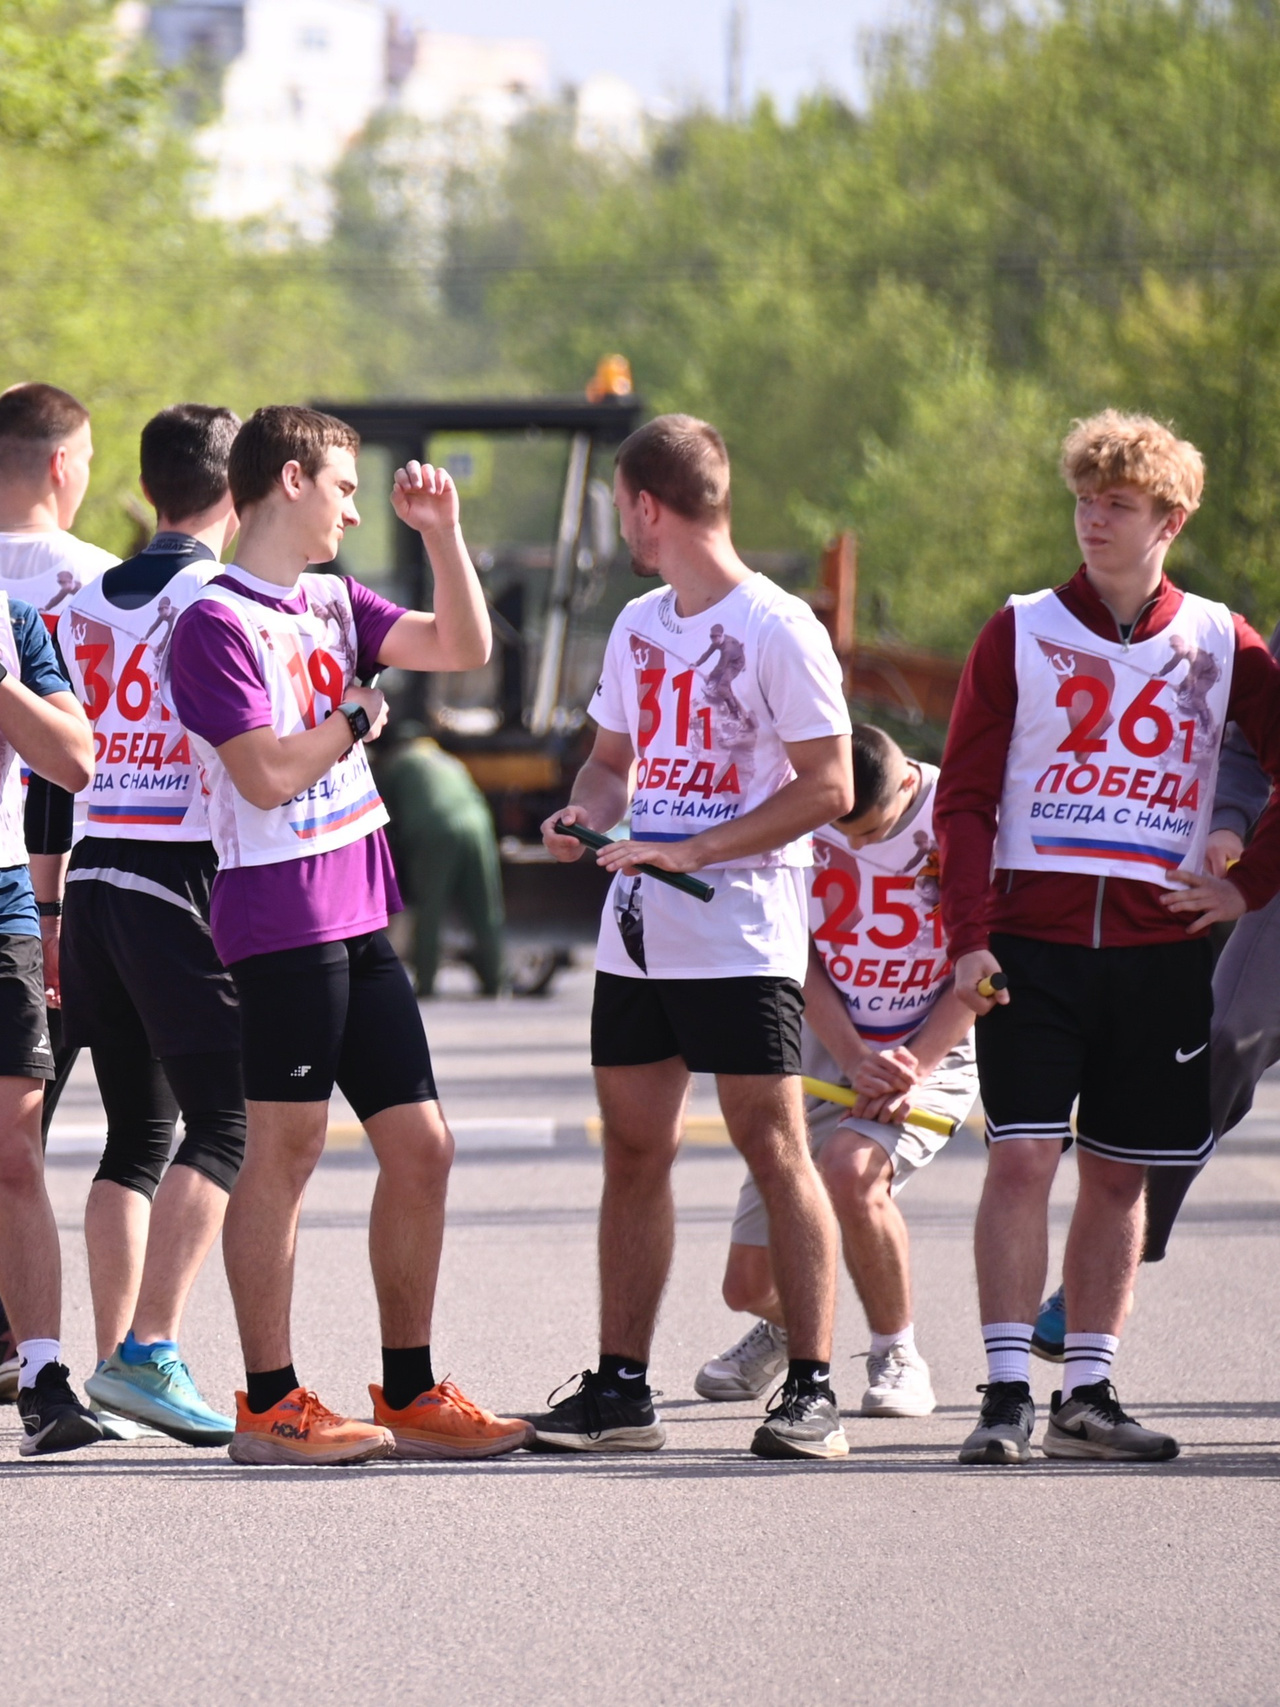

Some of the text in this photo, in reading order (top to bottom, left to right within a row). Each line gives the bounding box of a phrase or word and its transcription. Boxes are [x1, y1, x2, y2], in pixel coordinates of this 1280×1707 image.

[93, 732, 191, 771] ОБЕДА
[637, 757, 741, 800] ОБЕДА
[1034, 763, 1199, 813] ПОБЕДА
[671, 800, 739, 819] НАМИ!
[1030, 802, 1105, 824] ВСЕГДА
[1136, 811, 1194, 836] НАМИ!
[821, 952, 953, 994] ОБЕДА
